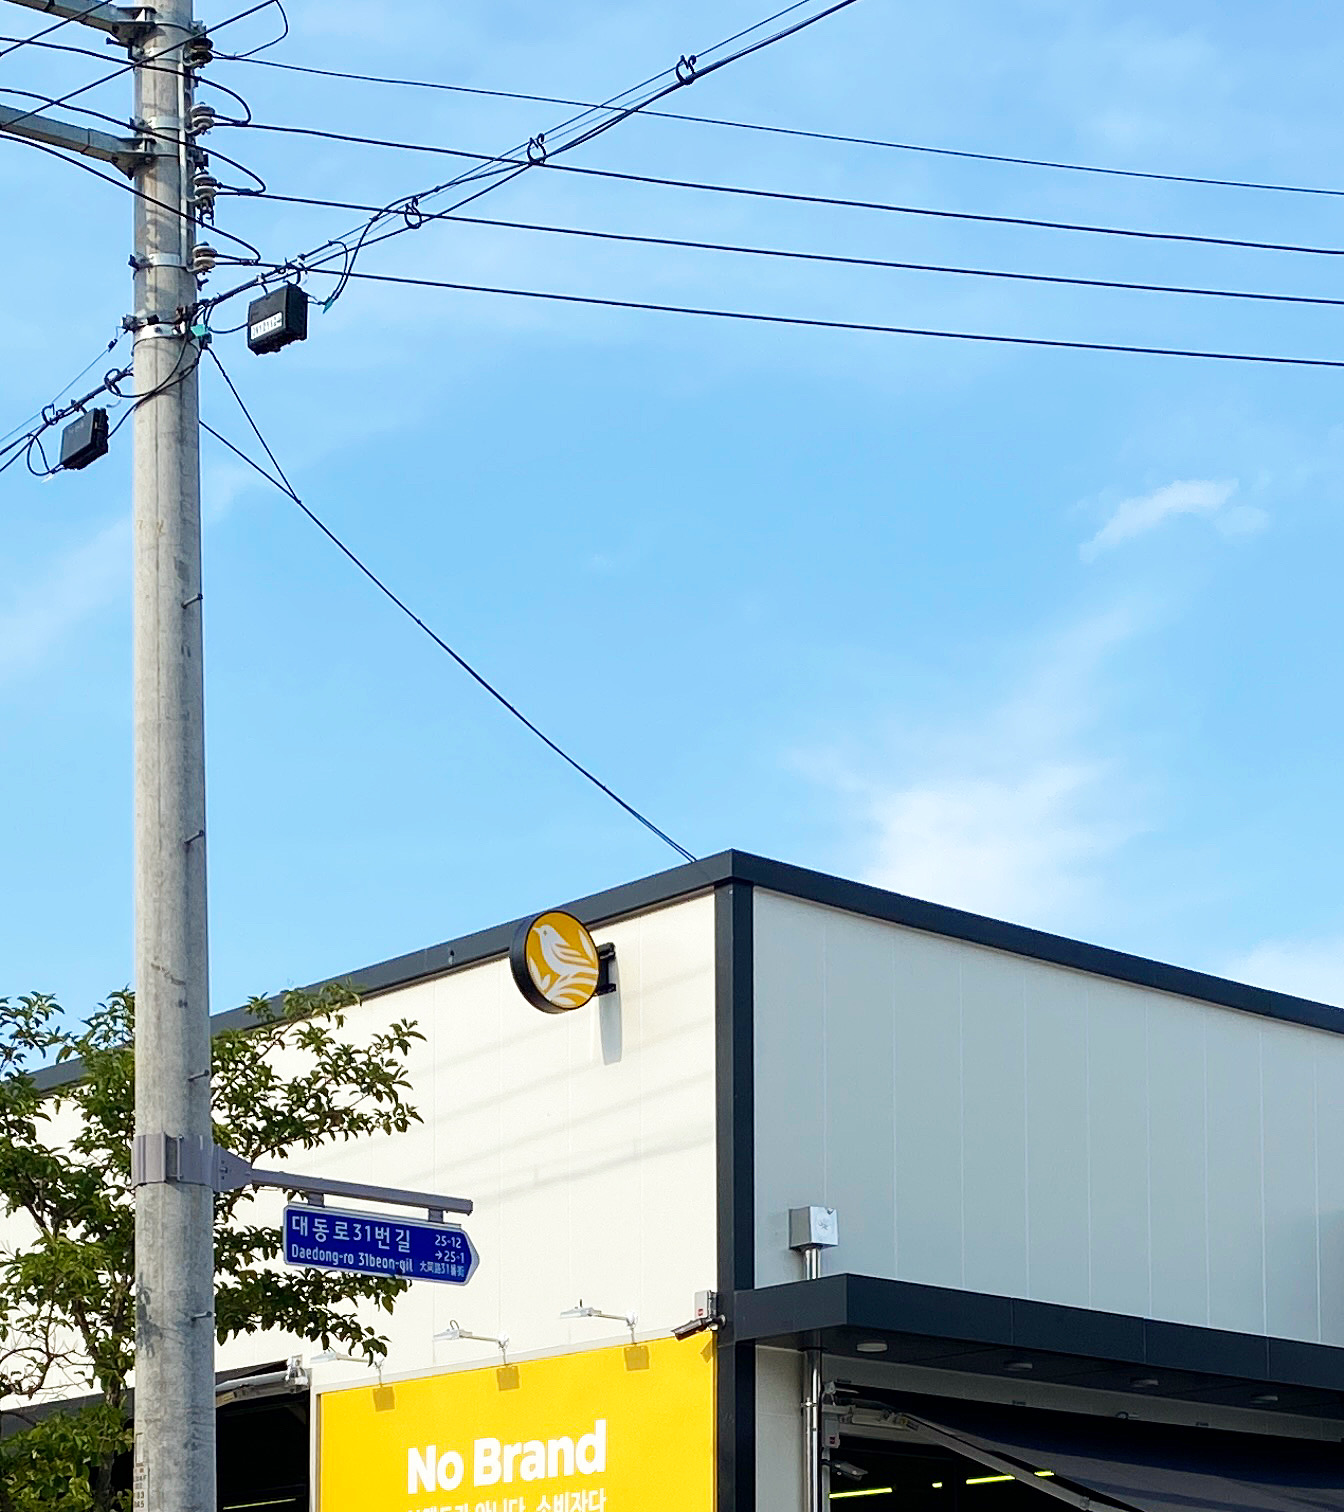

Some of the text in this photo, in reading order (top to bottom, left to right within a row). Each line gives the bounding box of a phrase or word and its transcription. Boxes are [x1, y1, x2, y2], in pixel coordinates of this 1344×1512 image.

[292, 1215, 411, 1254] 대동로31번길
[292, 1243, 413, 1275] Daedong-ro 31beon-gil
[407, 1418, 607, 1495] No Brand
